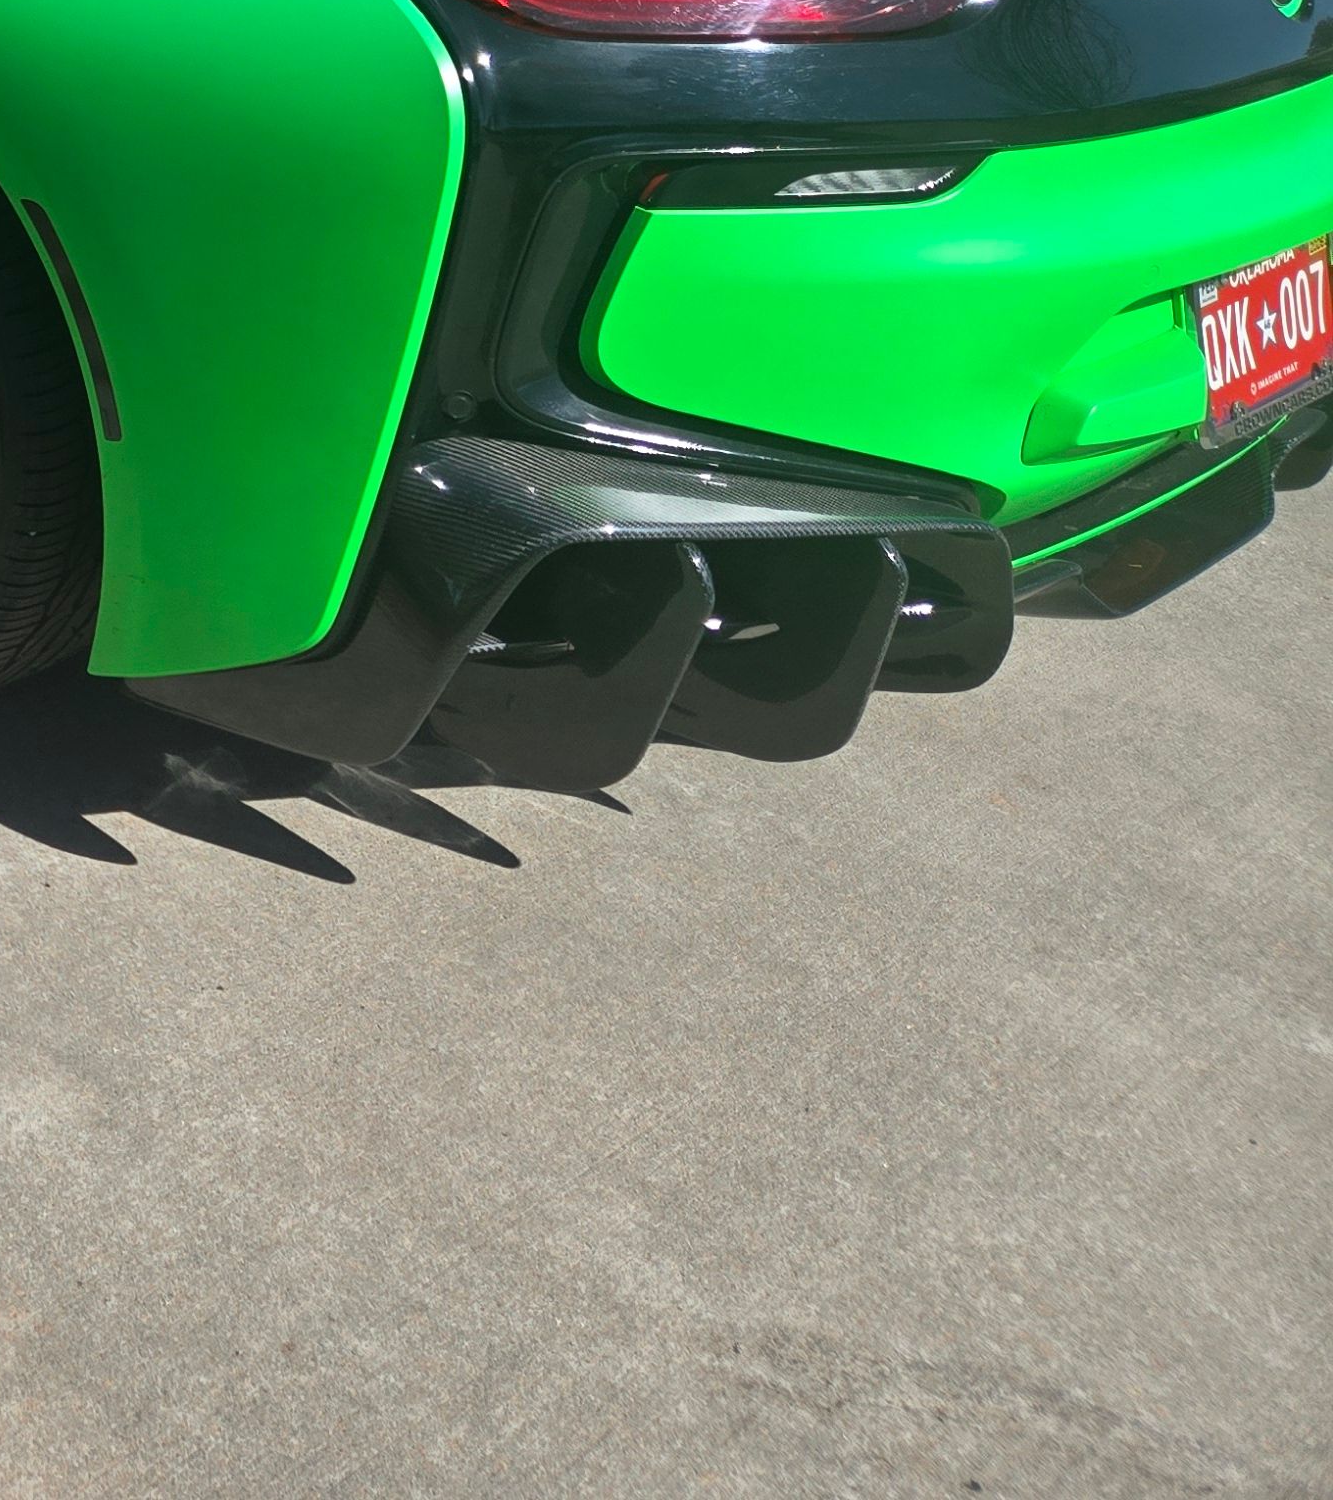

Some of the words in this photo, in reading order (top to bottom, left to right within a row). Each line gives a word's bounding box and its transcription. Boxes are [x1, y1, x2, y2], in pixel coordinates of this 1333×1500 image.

[1201, 296, 1257, 391] QXK
[1279, 260, 1326, 350] 007
[1257, 371, 1283, 391] IMAGINE
[1282, 361, 1299, 377] THAT
